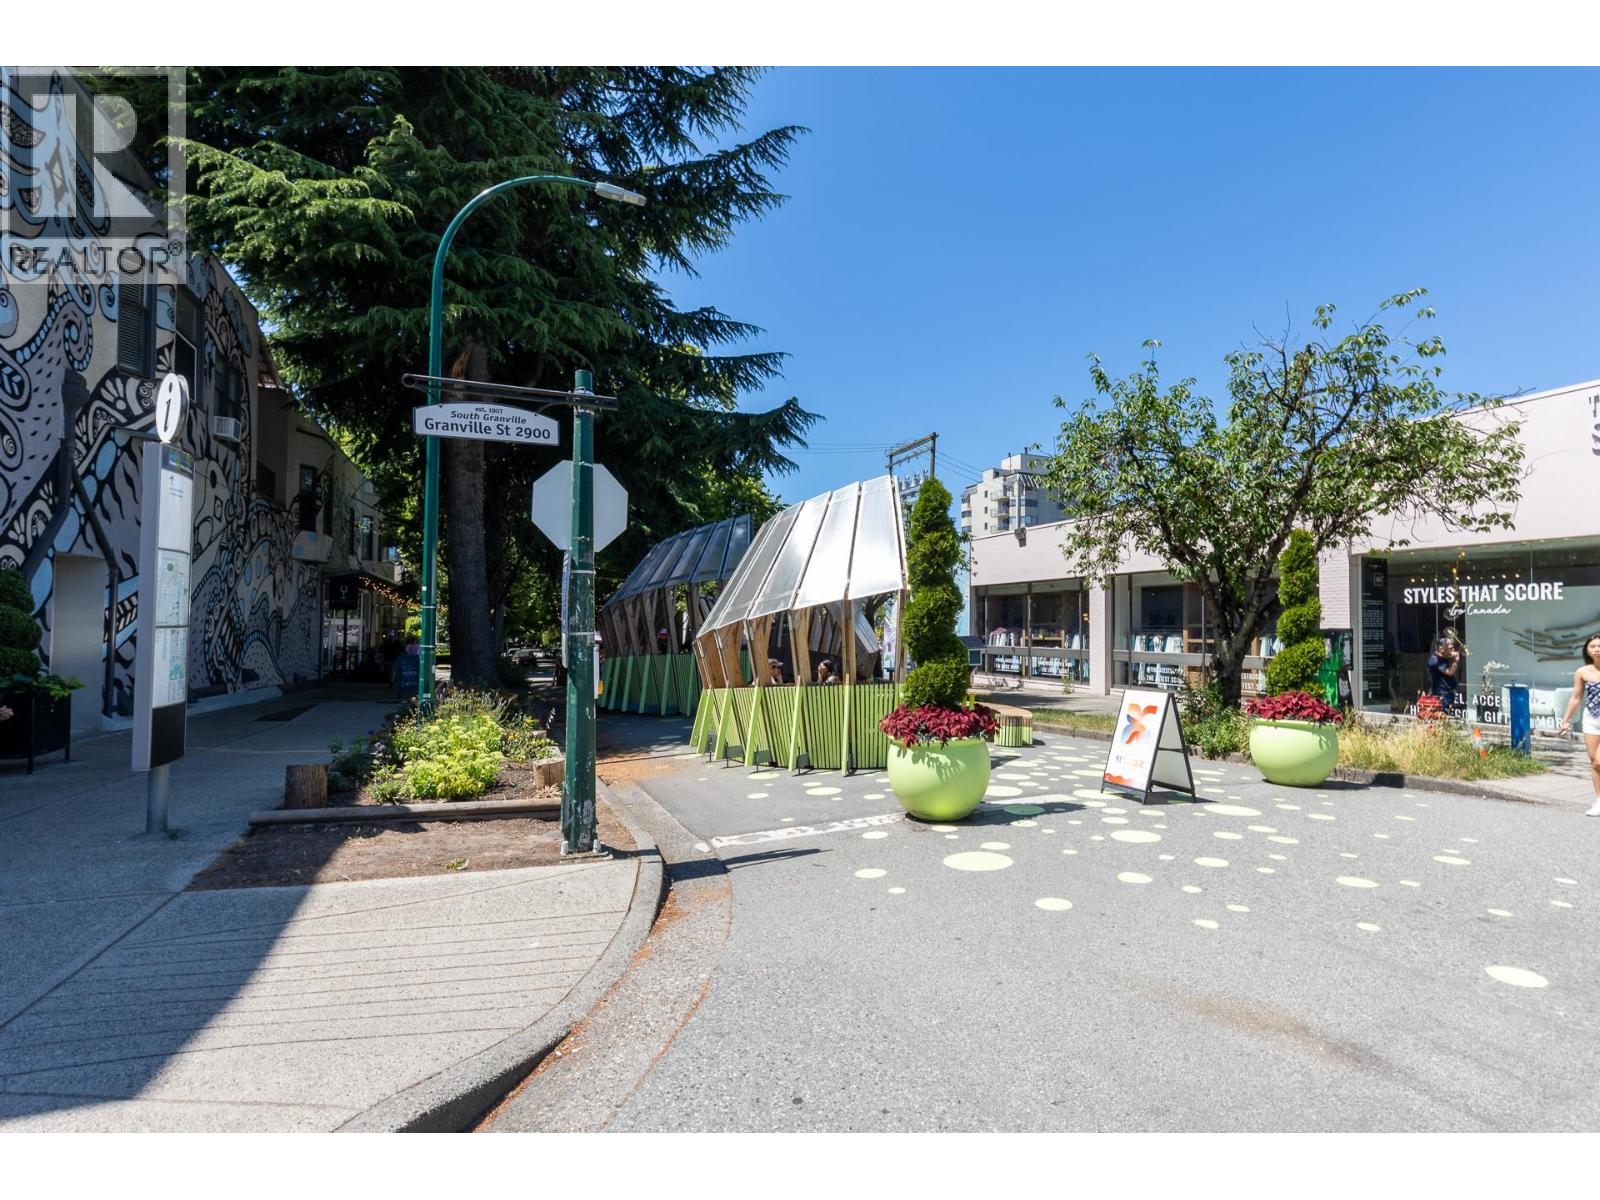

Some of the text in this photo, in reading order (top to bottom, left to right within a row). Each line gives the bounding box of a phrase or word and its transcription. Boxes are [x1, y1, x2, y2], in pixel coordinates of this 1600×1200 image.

[450, 410, 527, 424] South Granville
[424, 417, 551, 440] Granville St 2900
[1403, 581, 1564, 604] STYLES THAT SCORE
[1466, 603, 1512, 616] Canada
